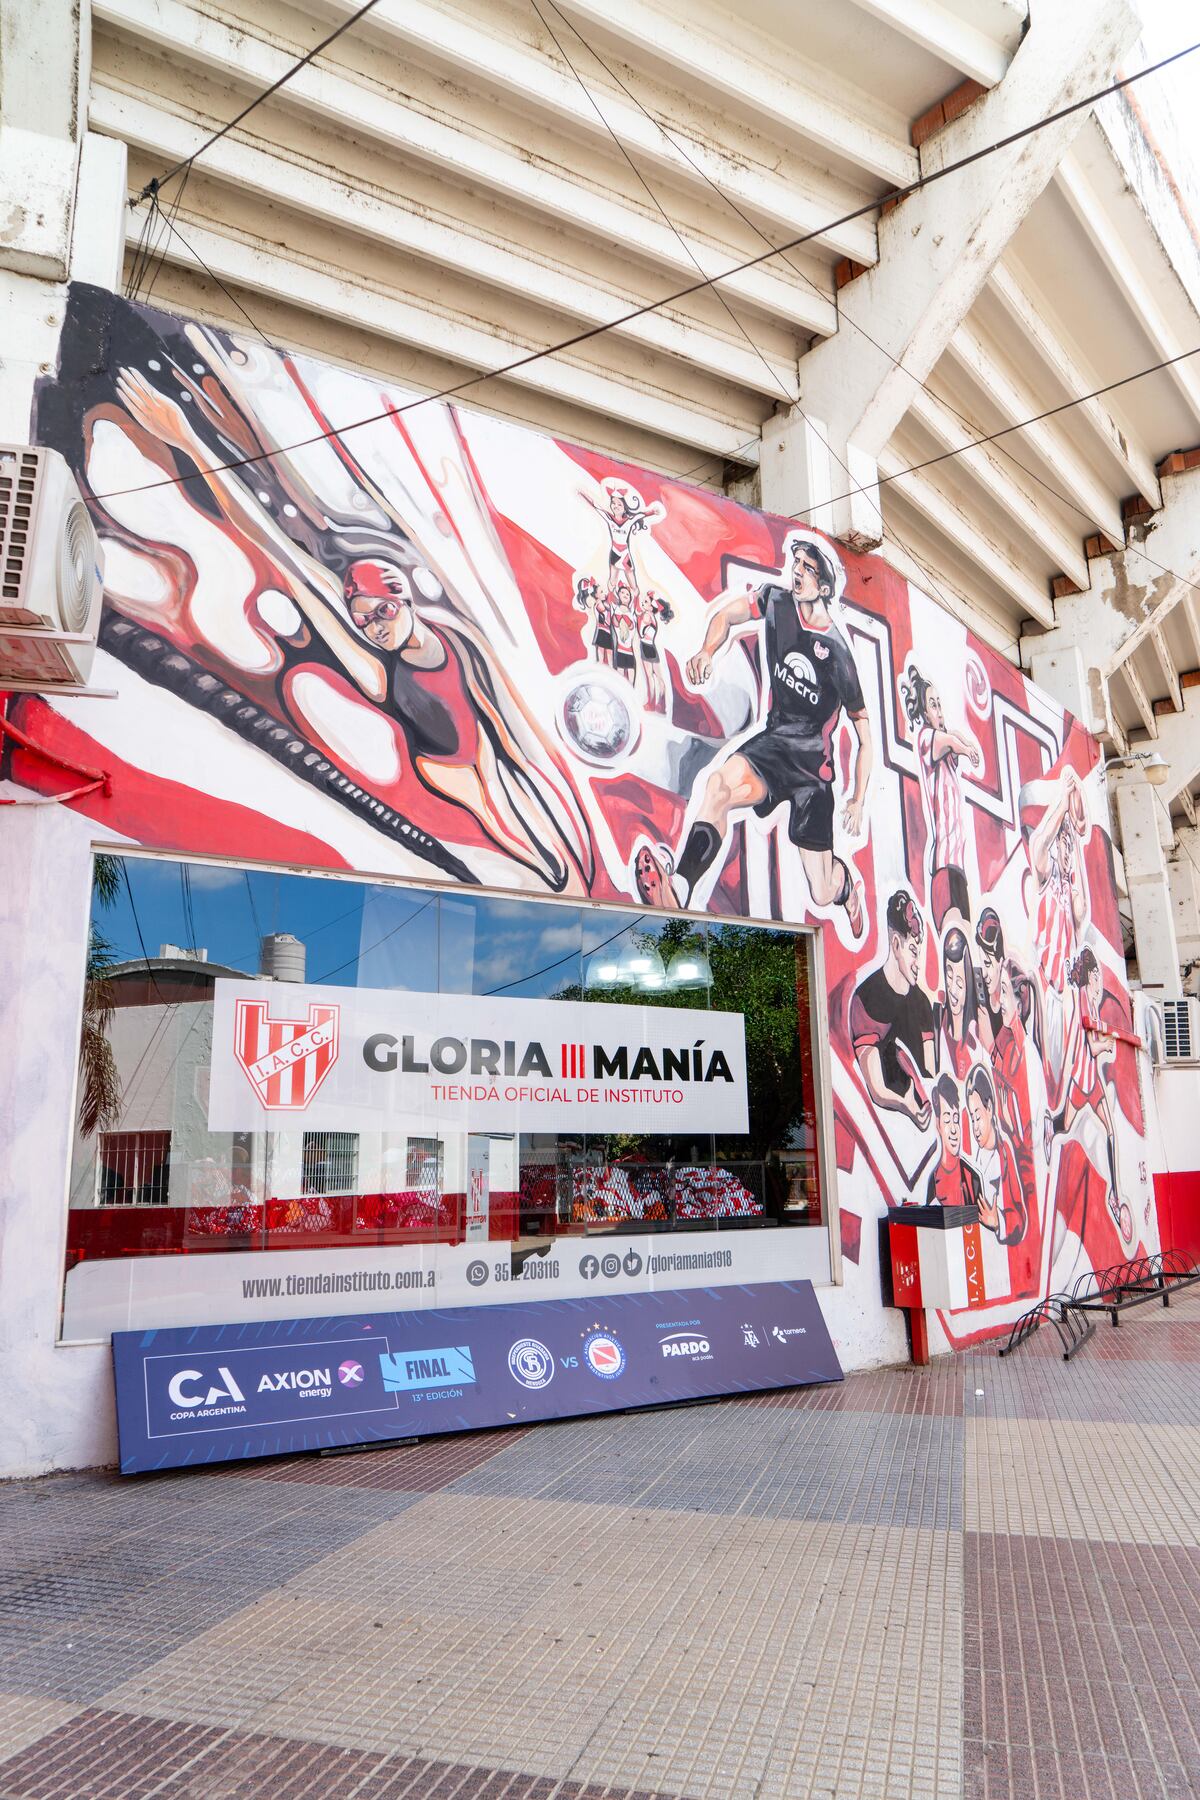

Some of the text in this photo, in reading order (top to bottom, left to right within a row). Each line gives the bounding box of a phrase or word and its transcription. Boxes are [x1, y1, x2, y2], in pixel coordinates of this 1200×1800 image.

[774, 663, 819, 705] Macro
[362, 1033, 735, 1082] GLORIA MANÍA
[431, 1085, 684, 1104] TIENDA OFICIAL DE INSTITUTO
[662, 1340, 710, 1357] PARDO
[405, 1358, 451, 1381] FINAL
[560, 1357, 579, 1368] VS
[257, 1368, 332, 1393] AXION
[299, 1386, 332, 1398] energy
[426, 1388, 463, 1401] EDICIÓN
[170, 1405, 247, 1420] COPA ARGENTINA
